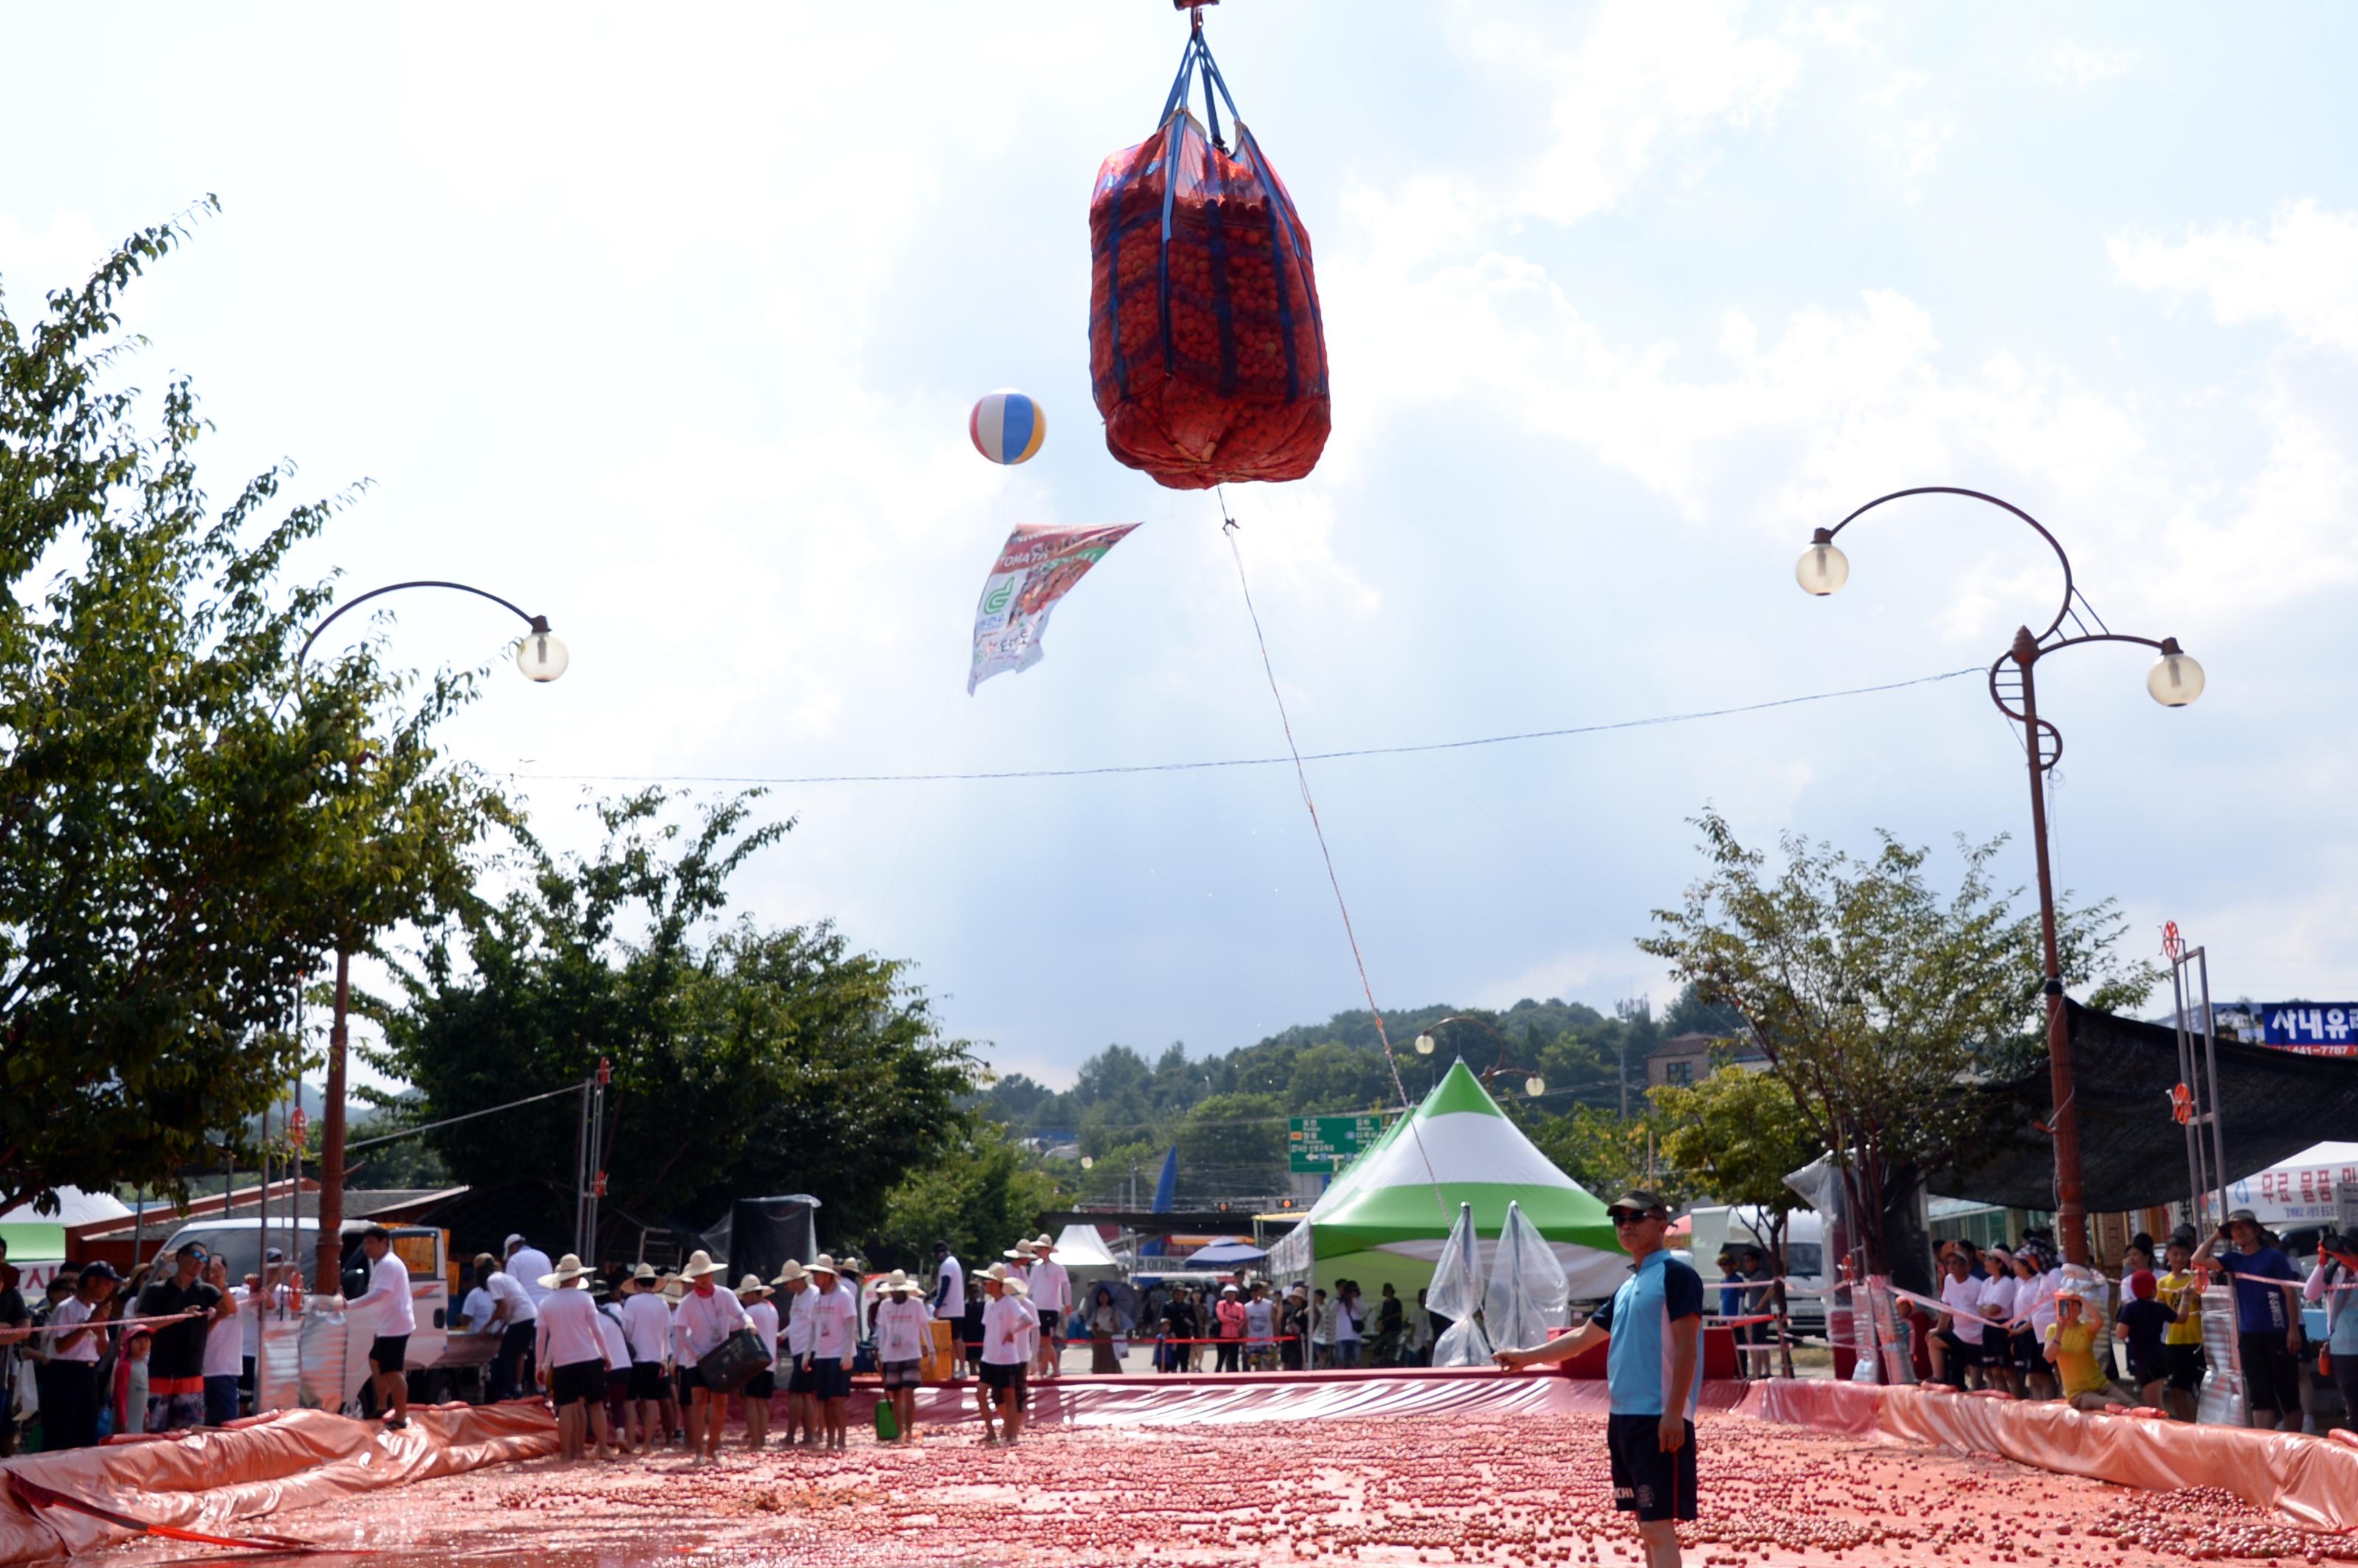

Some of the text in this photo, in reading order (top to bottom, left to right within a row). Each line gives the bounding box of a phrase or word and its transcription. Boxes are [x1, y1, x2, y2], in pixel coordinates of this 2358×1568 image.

[1000, 553, 1048, 567] TOMATO
[2262, 1172, 2292, 1204] 무료
[2300, 1169, 2333, 1203] 물품
